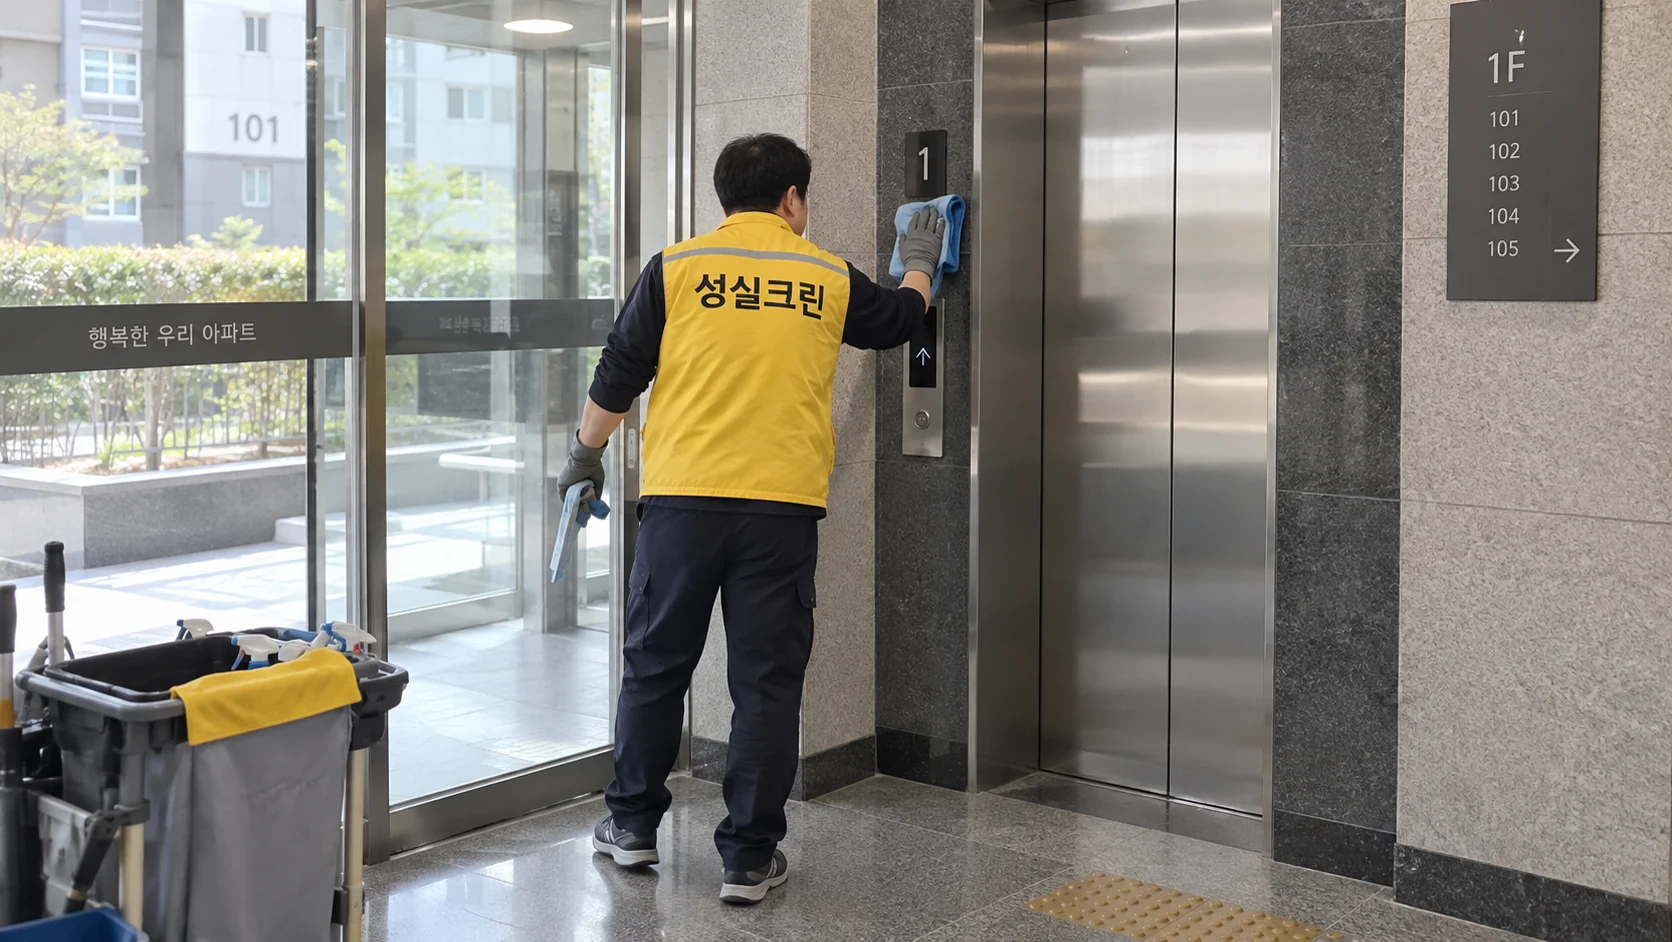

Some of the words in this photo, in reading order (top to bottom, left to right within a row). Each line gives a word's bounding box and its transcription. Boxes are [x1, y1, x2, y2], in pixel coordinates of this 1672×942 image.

[1488, 50, 1526, 84] 1F
[227, 113, 279, 143] 101
[1489, 109, 1519, 128] 101
[1489, 142, 1520, 160] 102
[918, 146, 929, 181] 1
[1488, 174, 1520, 192] 103
[1488, 207, 1520, 225] 104
[1487, 239, 1519, 257] 105
[694, 273, 825, 320] 성실크린
[88, 325, 150, 350] 행복한
[156, 323, 193, 347] 우리
[202, 321, 257, 345] 아파트
